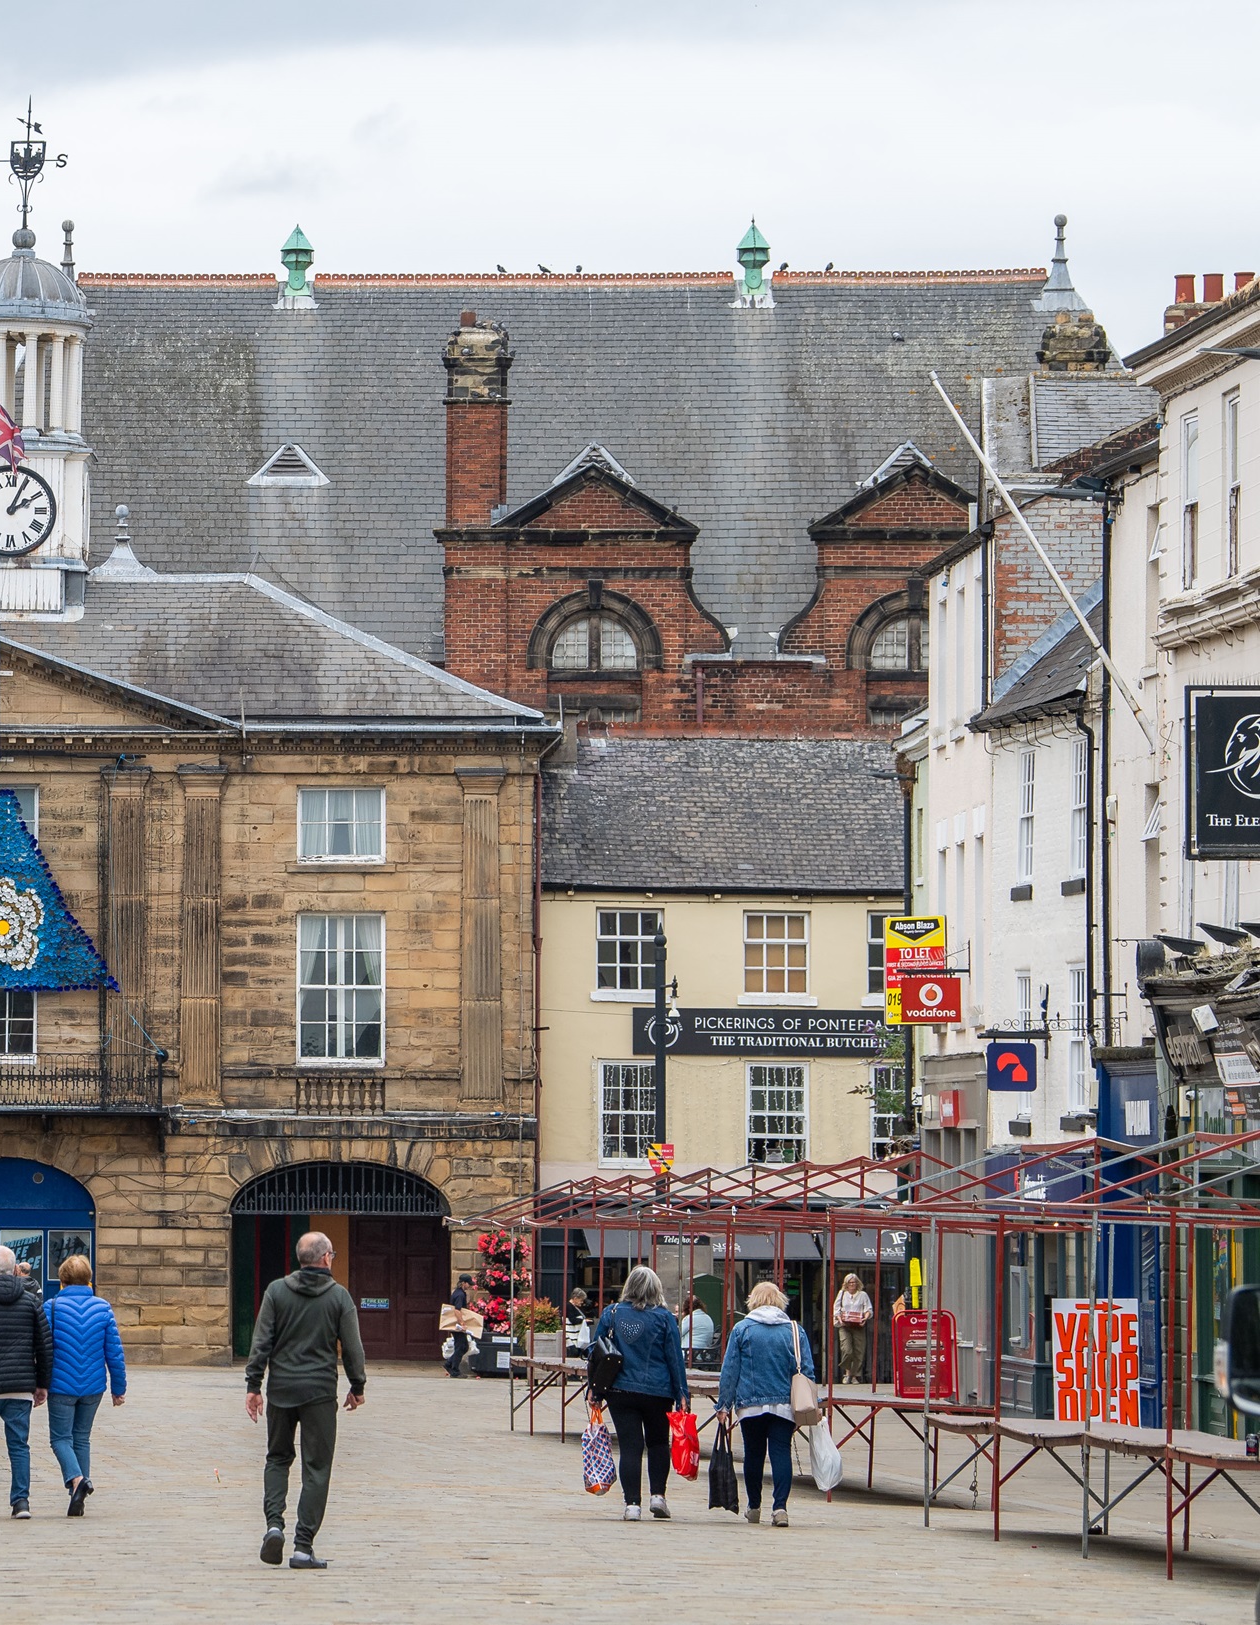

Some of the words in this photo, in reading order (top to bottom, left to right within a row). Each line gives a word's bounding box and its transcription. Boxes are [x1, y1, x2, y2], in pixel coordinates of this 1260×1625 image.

[56, 153, 68, 168] S
[895, 922, 915, 931] Abson
[899, 948, 912, 959] TO
[914, 947, 931, 959] LET
[906, 1007, 956, 1017] vodafone
[694, 1017, 775, 1030] PICKERINGS
[782, 1017, 802, 1030] OF
[710, 1035, 735, 1046] THE
[738, 1036, 823, 1048] TRADITIONAL
[1054, 1313, 1138, 1353] VAPE
[904, 1355, 922, 1363] Save
[1056, 1352, 1139, 1390] SHOP
[1058, 1389, 1139, 1427] OPEN
